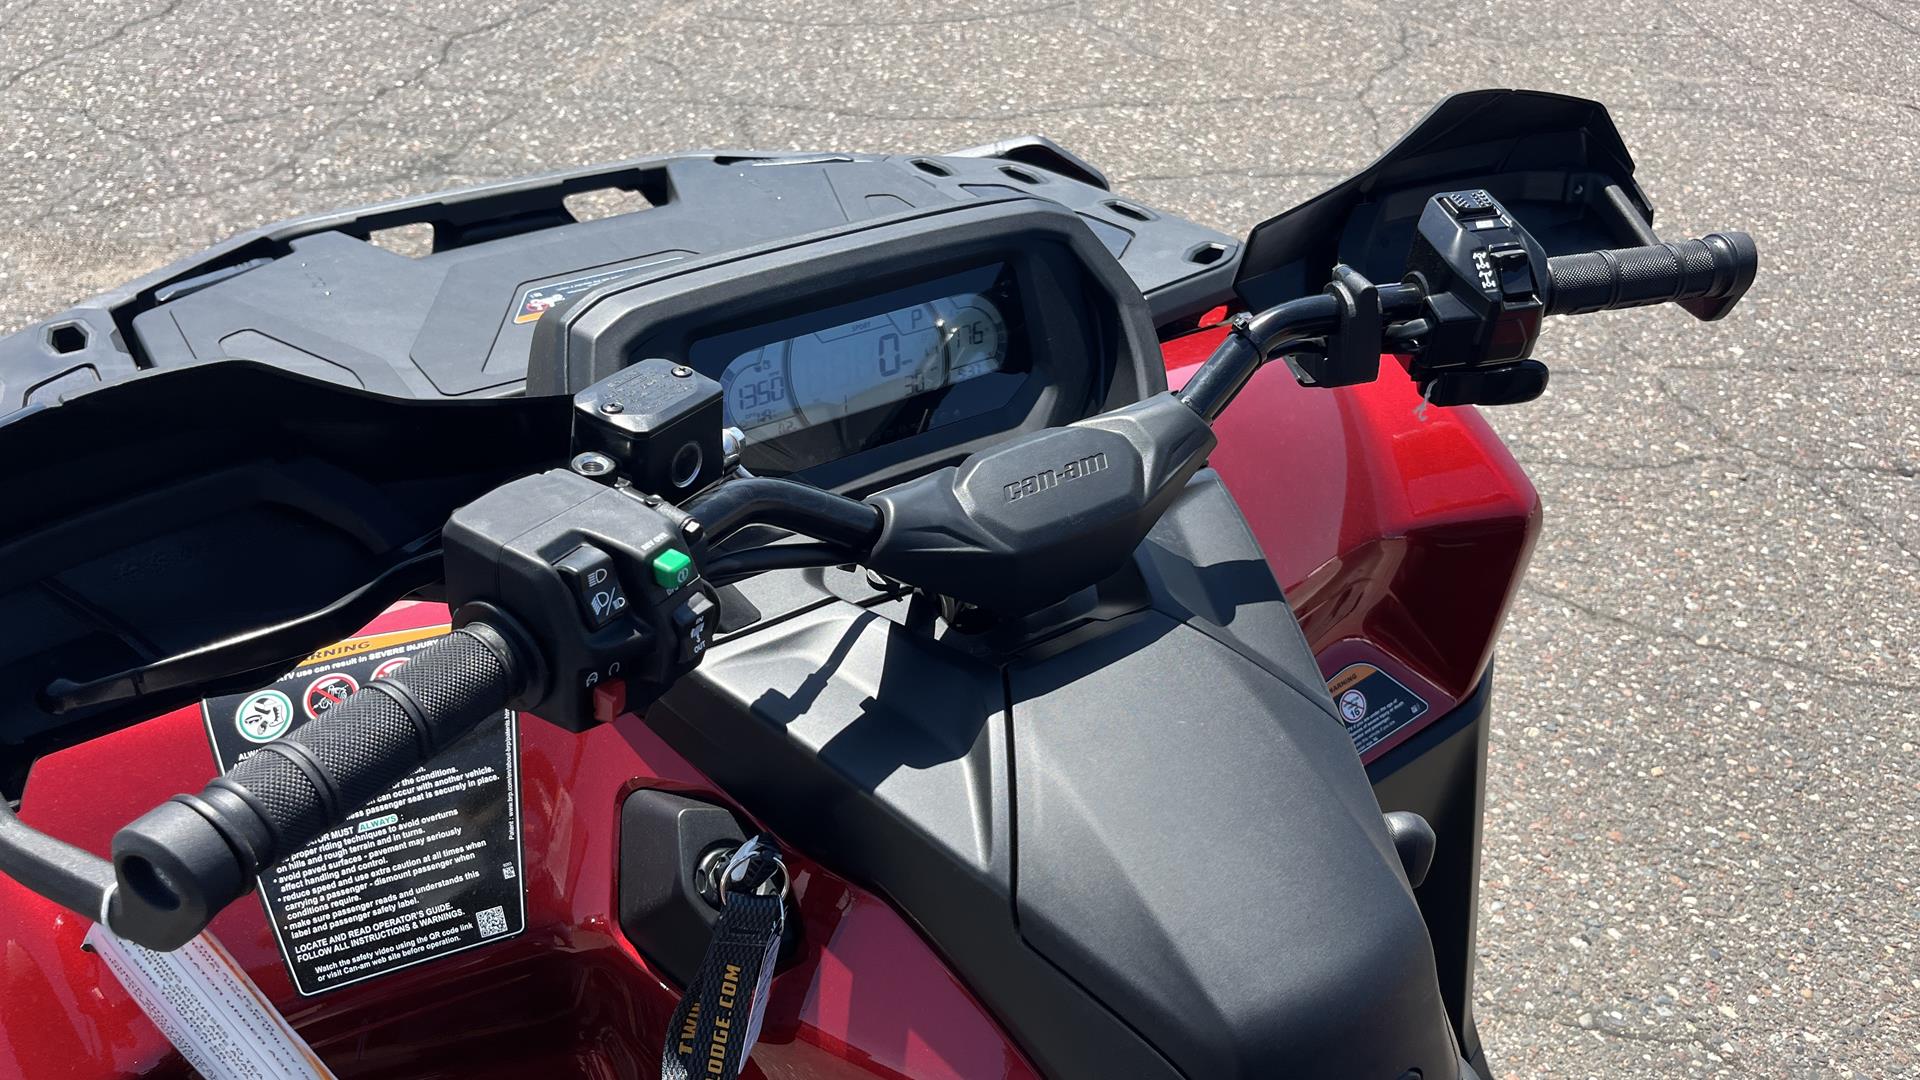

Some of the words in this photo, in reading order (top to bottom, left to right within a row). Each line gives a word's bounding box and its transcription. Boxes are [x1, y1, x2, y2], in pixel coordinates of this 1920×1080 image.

[911, 309, 922, 329] P
[739, 376, 784, 410] 1350
[1003, 452, 1109, 504] can-am
[296, 667, 313, 678] use
[314, 664, 331, 673] can
[332, 658, 358, 669] result
[358, 655, 368, 665] in
[368, 647, 406, 661] SEVERE
[406, 638, 439, 652] INJURY
[308, 641, 371, 661] RNING
[694, 641, 706, 653] OUT
[1350, 709, 1360, 718] 16
[365, 798, 406, 816] passenger
[406, 792, 424, 803] seat
[424, 790, 433, 798] is
[433, 782, 466, 796] securely
[467, 779, 476, 787] in
[476, 774, 500, 786] place.
[376, 793, 391, 802] can
[392, 786, 415, 798] occur
[415, 781, 433, 791] with
[434, 773, 463, 787] another
[464, 766, 494, 778] vehicle.
[400, 777, 414, 786] the
[415, 766, 458, 782] conditions.
[290, 847, 317, 861] proper
[318, 840, 343, 852] riding
[342, 828, 387, 845] techniques
[387, 825, 397, 833] to
[398, 817, 420, 830] avoid
[420, 808, 458, 824] overturns
[330, 826, 353, 839] MUST
[359, 815, 397, 831] ALWAYS
[276, 865, 288, 873] on
[288, 859, 306, 870] hills
[306, 853, 323, 865] and
[323, 847, 348, 860] rough
[348, 840, 376, 853] terrain
[376, 835, 392, 846] and
[392, 833, 401, 841] in
[401, 827, 425, 838] turns.
[278, 870, 301, 883] avoid
[301, 862, 327, 878] paved
[327, 854, 362, 870] surfaces
[368, 841, 407, 860] pavement
[407, 837, 424, 847] may
[426, 826, 461, 842] seriously
[282, 889, 310, 902] reduce
[311, 880, 336, 894] speed
[337, 875, 353, 887] and
[354, 872, 369, 882] use
[370, 866, 391, 877] extra
[391, 858, 422, 871] caution
[422, 854, 431, 863] at
[431, 850, 442, 860] all
[442, 846, 464, 857] times
[465, 840, 486, 850] when
[280, 879, 304, 892] affect
[304, 870, 340, 886] handling
[340, 864, 356, 876] and
[357, 856, 388, 871] control.
[284, 896, 318, 911] carrying
[319, 894, 325, 902] a
[325, 882, 367, 901] passenger
[373, 869, 412, 886] dismount
[412, 858, 453, 877] passenger
[453, 852, 475, 863] when
[286, 903, 329, 920] conditions
[330, 894, 361, 908] require.
[289, 918, 311, 930] make
[312, 913, 330, 923] sure
[331, 900, 373, 919] passenger
[374, 893, 397, 905] reads
[398, 887, 414, 899] and
[415, 874, 464, 894] understands
[464, 870, 480, 880] this
[290, 926, 311, 939] label
[312, 922, 328, 933] and
[328, 910, 370, 929] passenger
[372, 903, 396, 916] safety
[397, 896, 419, 908] label.
[294, 937, 328, 954] LOCATE
[329, 932, 347, 944] AND
[347, 925, 371, 938] READ
[372, 910, 424, 931] OPERATOR'S
[425, 902, 453, 916] GUIDE.
[296, 946, 332, 963] FOLLOW
[333, 941, 350, 952] ALL
[350, 923, 410, 947] INSTRUCTIONS
[412, 921, 418, 929] &
[418, 908, 465, 927] WARNINGS.
[314, 961, 338, 973] Watch
[338, 958, 350, 967] the
[351, 952, 373, 963] safety
[374, 946, 394, 956] video
[395, 939, 416, 950] using
[416, 935, 428, 944] the
[428, 931, 441, 940] QR
[441, 926, 459, 936] code
[459, 922, 473, 931] link
[317, 974, 325, 982] or
[326, 969, 342, 978] visit
[343, 961, 371, 974] Can-am
[371, 956, 387, 965] web
[387, 952, 401, 961] site
[401, 945, 424, 956] before
[425, 935, 461, 949] operation.
[151, 948, 183, 984] INING
[182, 984, 230, 1039] COURSES
[229, 1040, 244, 1056] TO
[152, 966, 217, 1041] INFORMATION
[160, 983, 188, 1014] YOUR
[173, 982, 208, 1022] SKILLS
[208, 1023, 229, 1047] ARE
